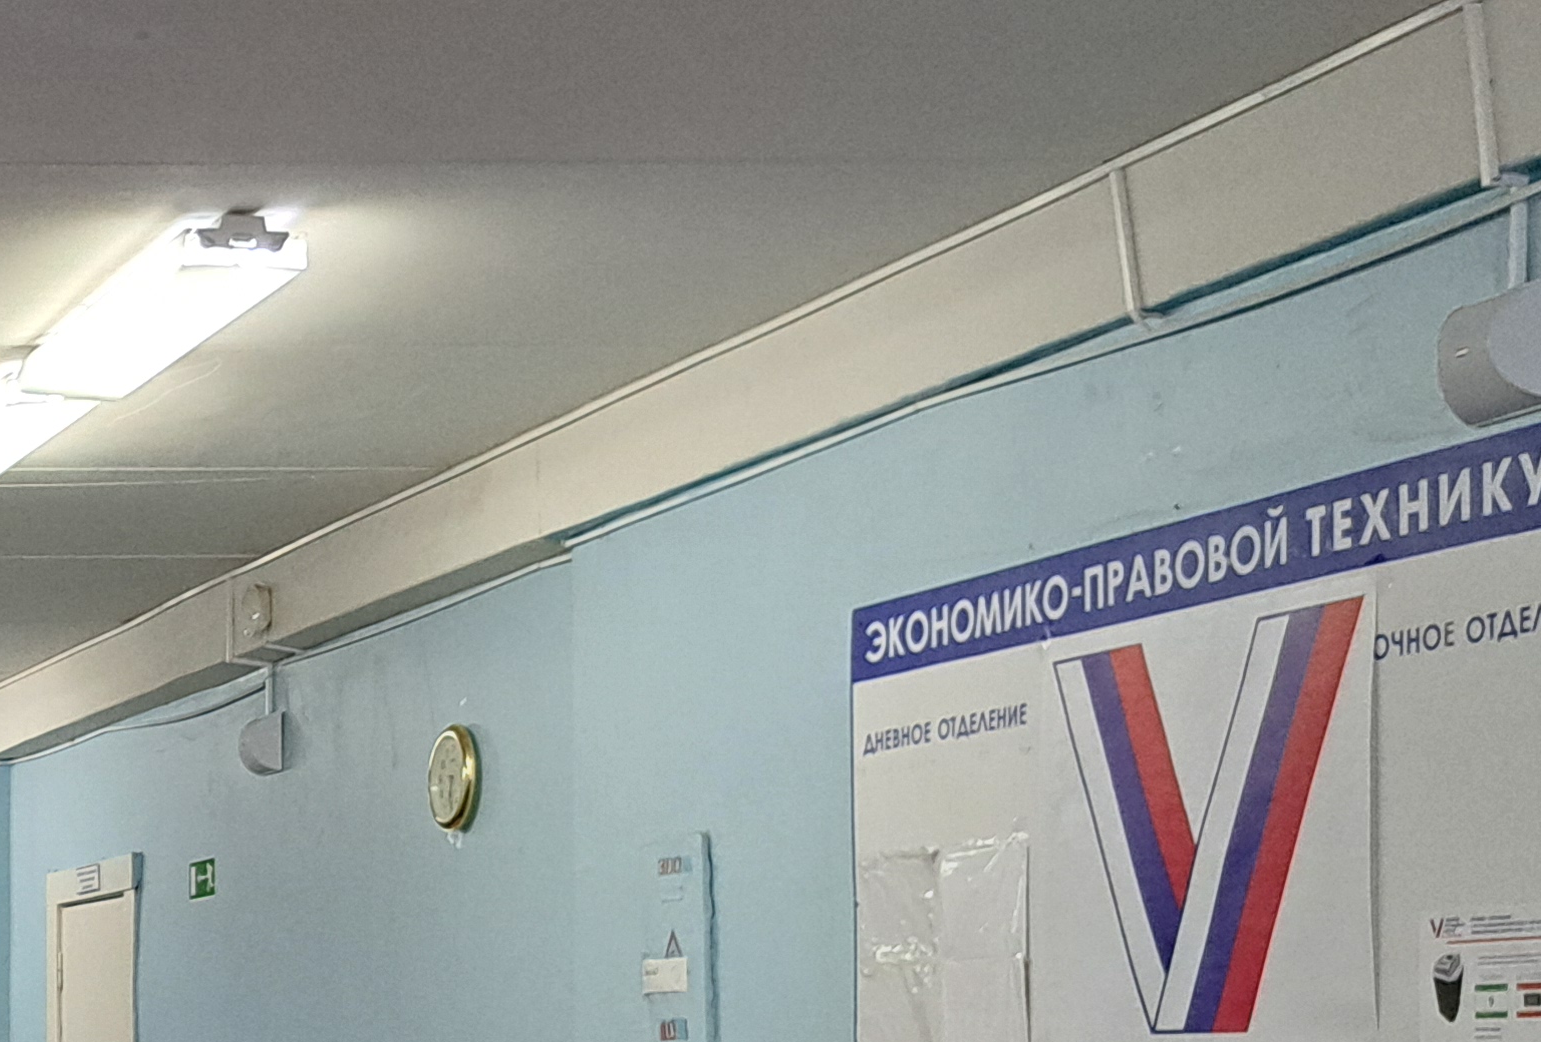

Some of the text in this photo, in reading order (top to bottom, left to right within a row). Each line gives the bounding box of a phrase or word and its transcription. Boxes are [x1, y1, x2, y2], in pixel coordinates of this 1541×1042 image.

[864, 504, 1288, 664] ЭКОНОМИКО-ПРАВОВОЙ
[863, 702, 1028, 756] ДНЕВНОЕ ОТДЕЛЕНИЕ
